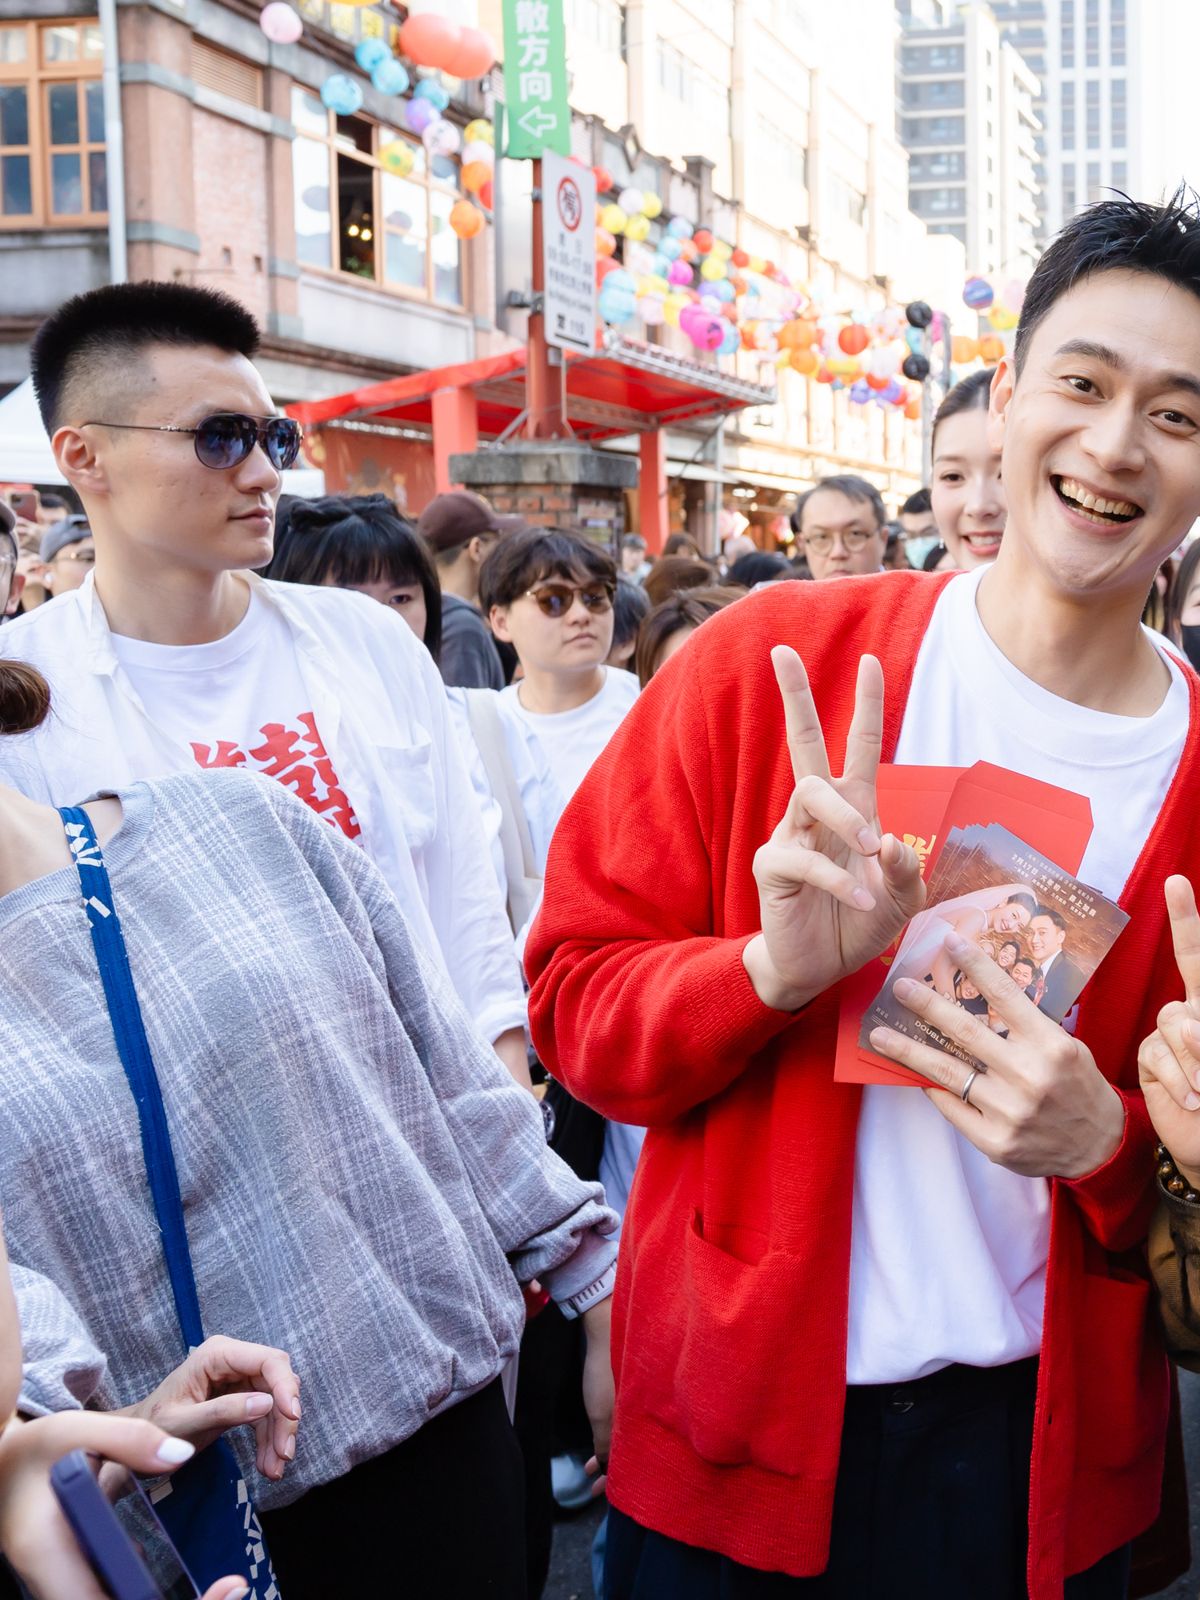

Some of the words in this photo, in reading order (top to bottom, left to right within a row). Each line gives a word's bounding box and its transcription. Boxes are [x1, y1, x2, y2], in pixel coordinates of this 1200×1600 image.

[516, 0, 552, 102] 散方向
[914, 1020, 946, 1046] DOUBLE
